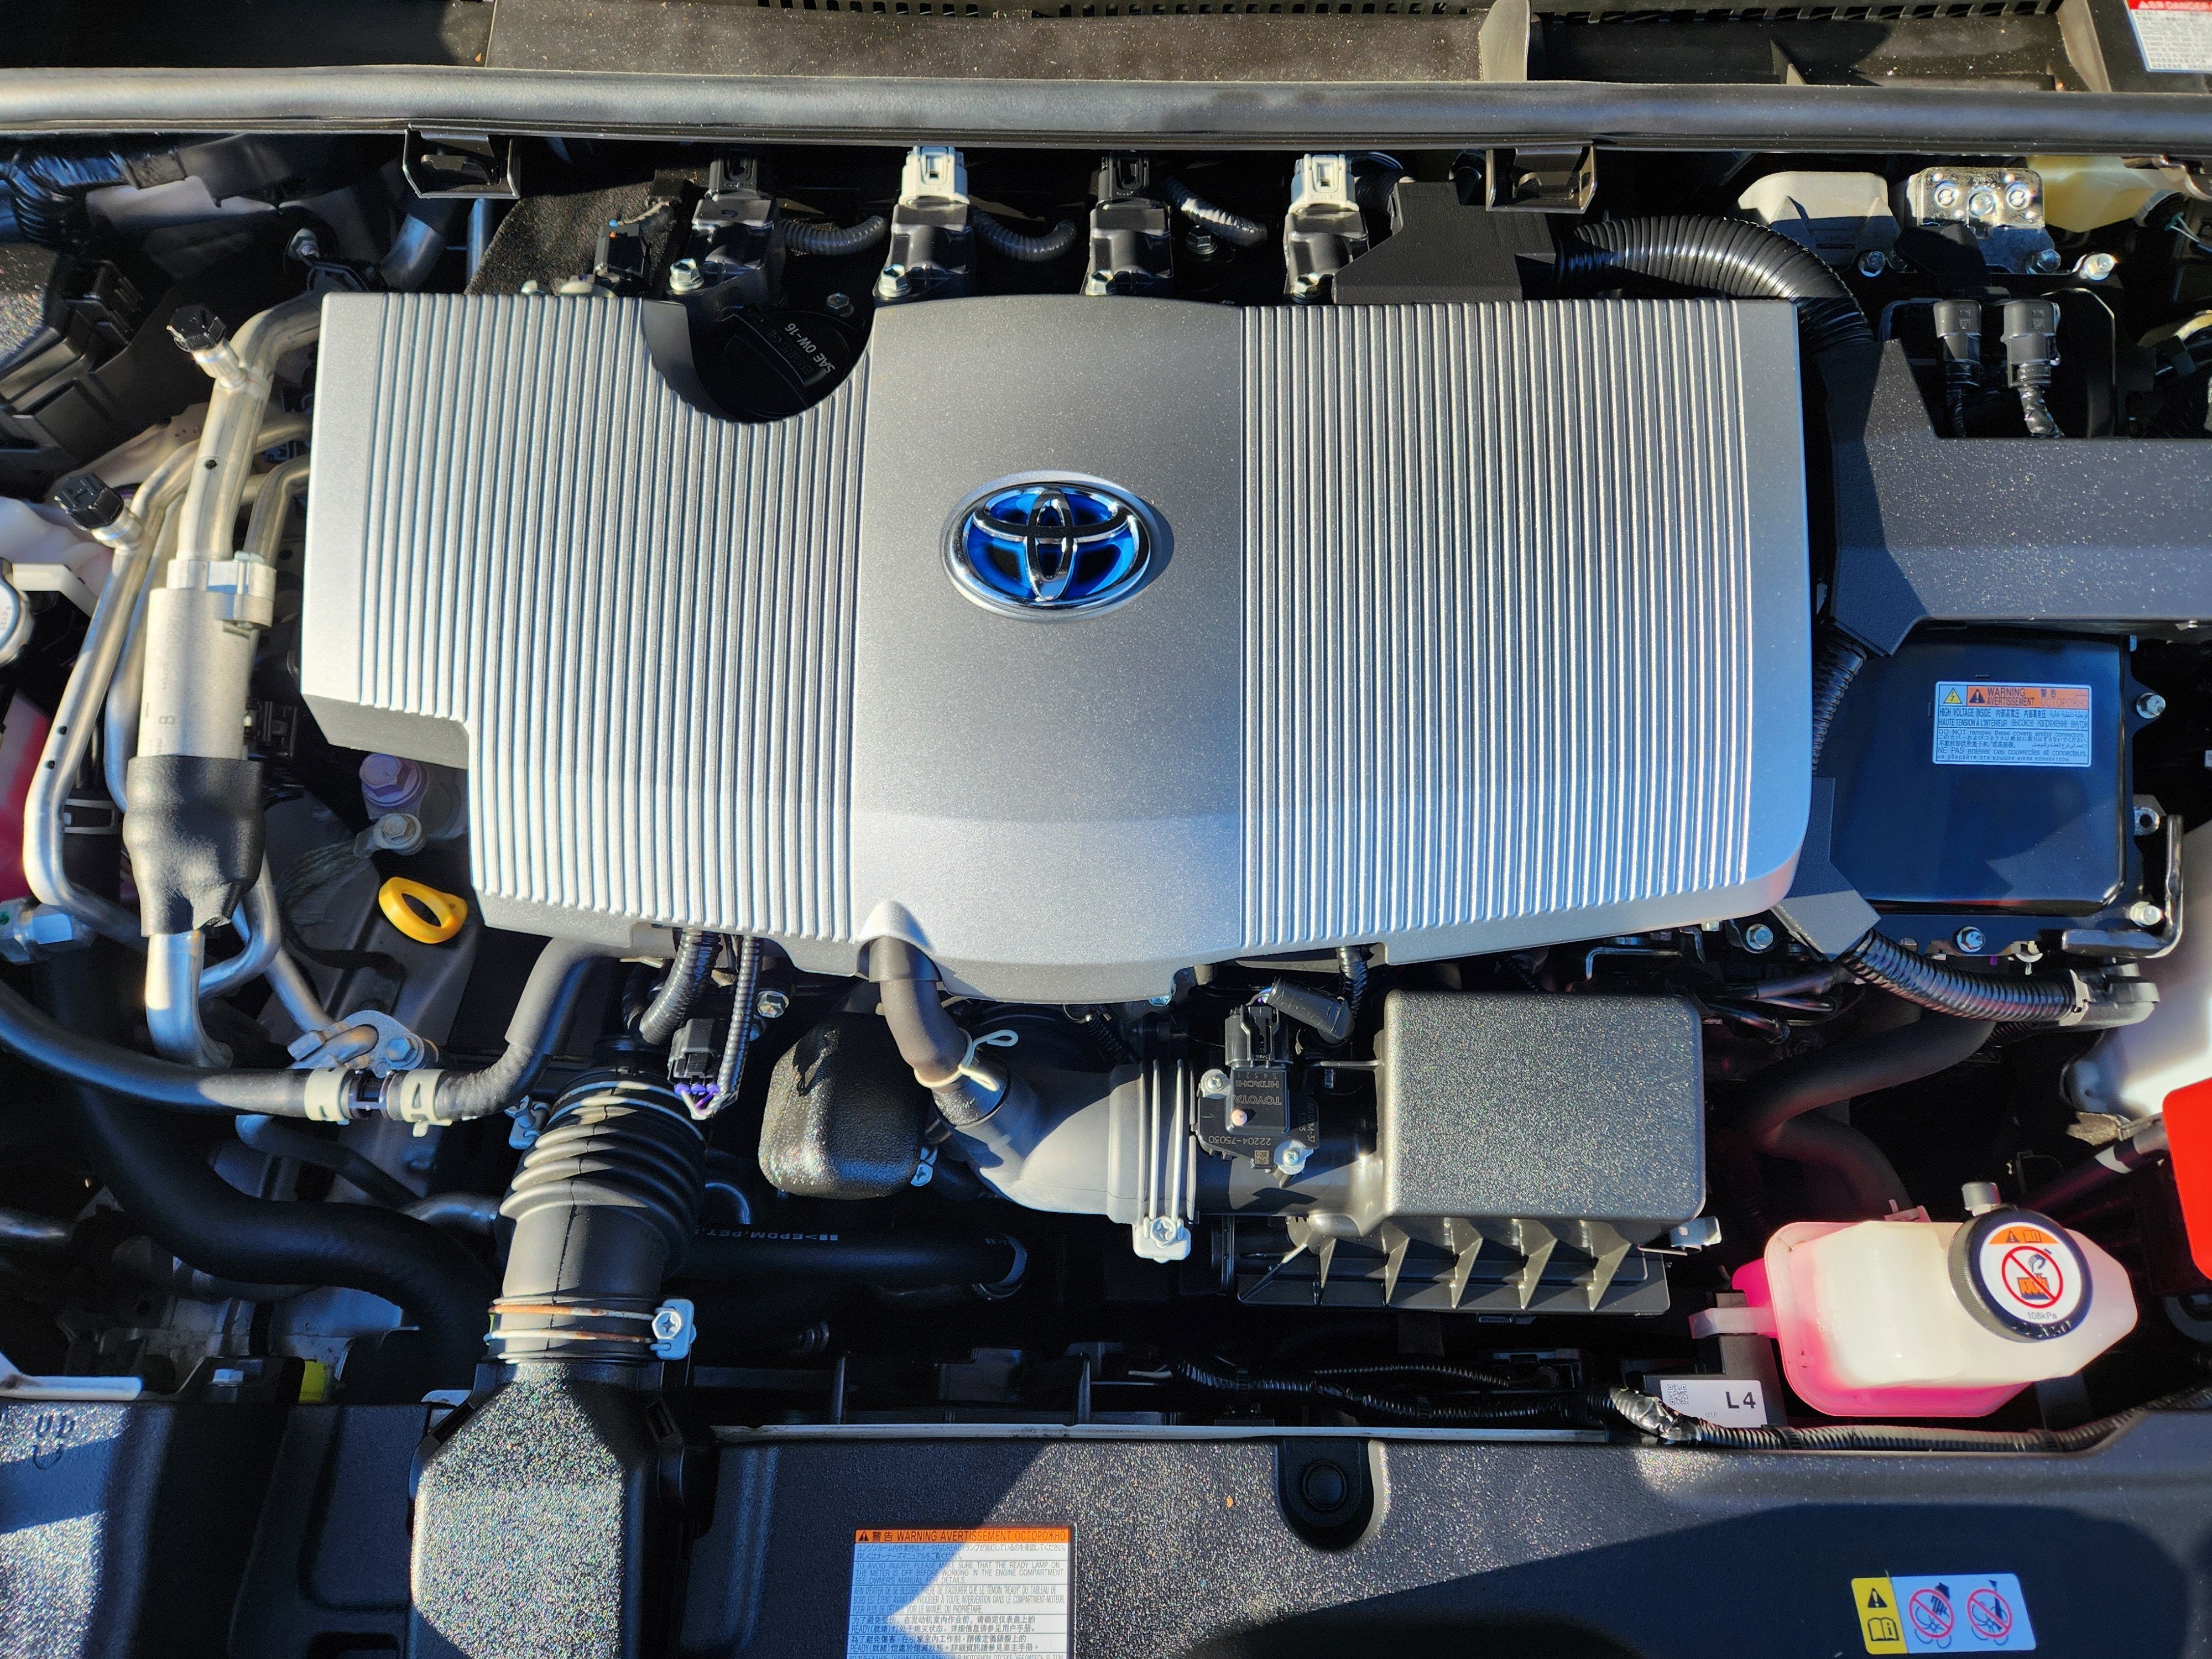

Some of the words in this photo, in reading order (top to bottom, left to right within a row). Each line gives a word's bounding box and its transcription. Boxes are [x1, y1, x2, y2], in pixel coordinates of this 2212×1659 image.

[785, 323, 817, 353] 0W-16
[813, 353, 835, 373] SAE
[1987, 687, 2026, 697] WARNING
[1987, 696, 2034, 706] AVERTISSEMENT
[1939, 707, 1951, 717] HIGH
[1954, 708, 1974, 717] VOLTAGE
[1976, 708, 1991, 717] INSIDE
[1976, 718, 1980, 727] À
[1981, 718, 2007, 727] L'INTÉRIEUR
[1236, 1079, 1280, 1088] HITACHI
[1233, 1094, 1282, 1105] TOYOTA
[1208, 1135, 1271, 1146] 22204-75030
[2027, 1311, 2058, 1320] 108kPa
[1725, 1391, 1756, 1409] L4
[897, 1531, 937, 1542] WARNING
[940, 1530, 1011, 1541] AVERTISSEMENT
[1015, 1530, 1066, 1541] ОСТОРОЖНО
[854, 1586, 864, 1595] AFIN
[885, 1586, 891, 1595] DE
[893, 1586, 898, 1595] SE
[937, 1586, 943, 1595] DE
[969, 1585, 977, 1594] QUE
[979, 1585, 984, 1594] LE
[987, 1584, 1003, 1594] TÉMOIN
[1022, 1585, 1029, 1594] DU
[1031, 1585, 1049, 1594] TABLEAU
[1051, 1585, 1057, 1594] DE
[853, 1596, 865, 1604] BORD
[878, 1595, 891, 1604] ÉTEINT
[894, 1596, 907, 1604] AVANT
[910, 1596, 915, 1604] DE
[917, 1595, 939, 1604] PROCÉDER
[941, 1595, 945, 1604] À
[947, 1596, 960, 1604] TOUTE
[962, 1595, 990, 1604] INTERVENTION
[993, 1595, 1004, 1604] DANS
[1006, 1595, 1011, 1604] LE
[852, 1605, 865, 1614] POUR
[867, 1605, 878, 1614] PLUS
[879, 1605, 885, 1614] DE
[907, 1605, 917, 1614] VOIR
[919, 1605, 924, 1613] LE
[926, 1605, 942, 1613] MANUEL
[945, 1605, 951, 1613] DU
